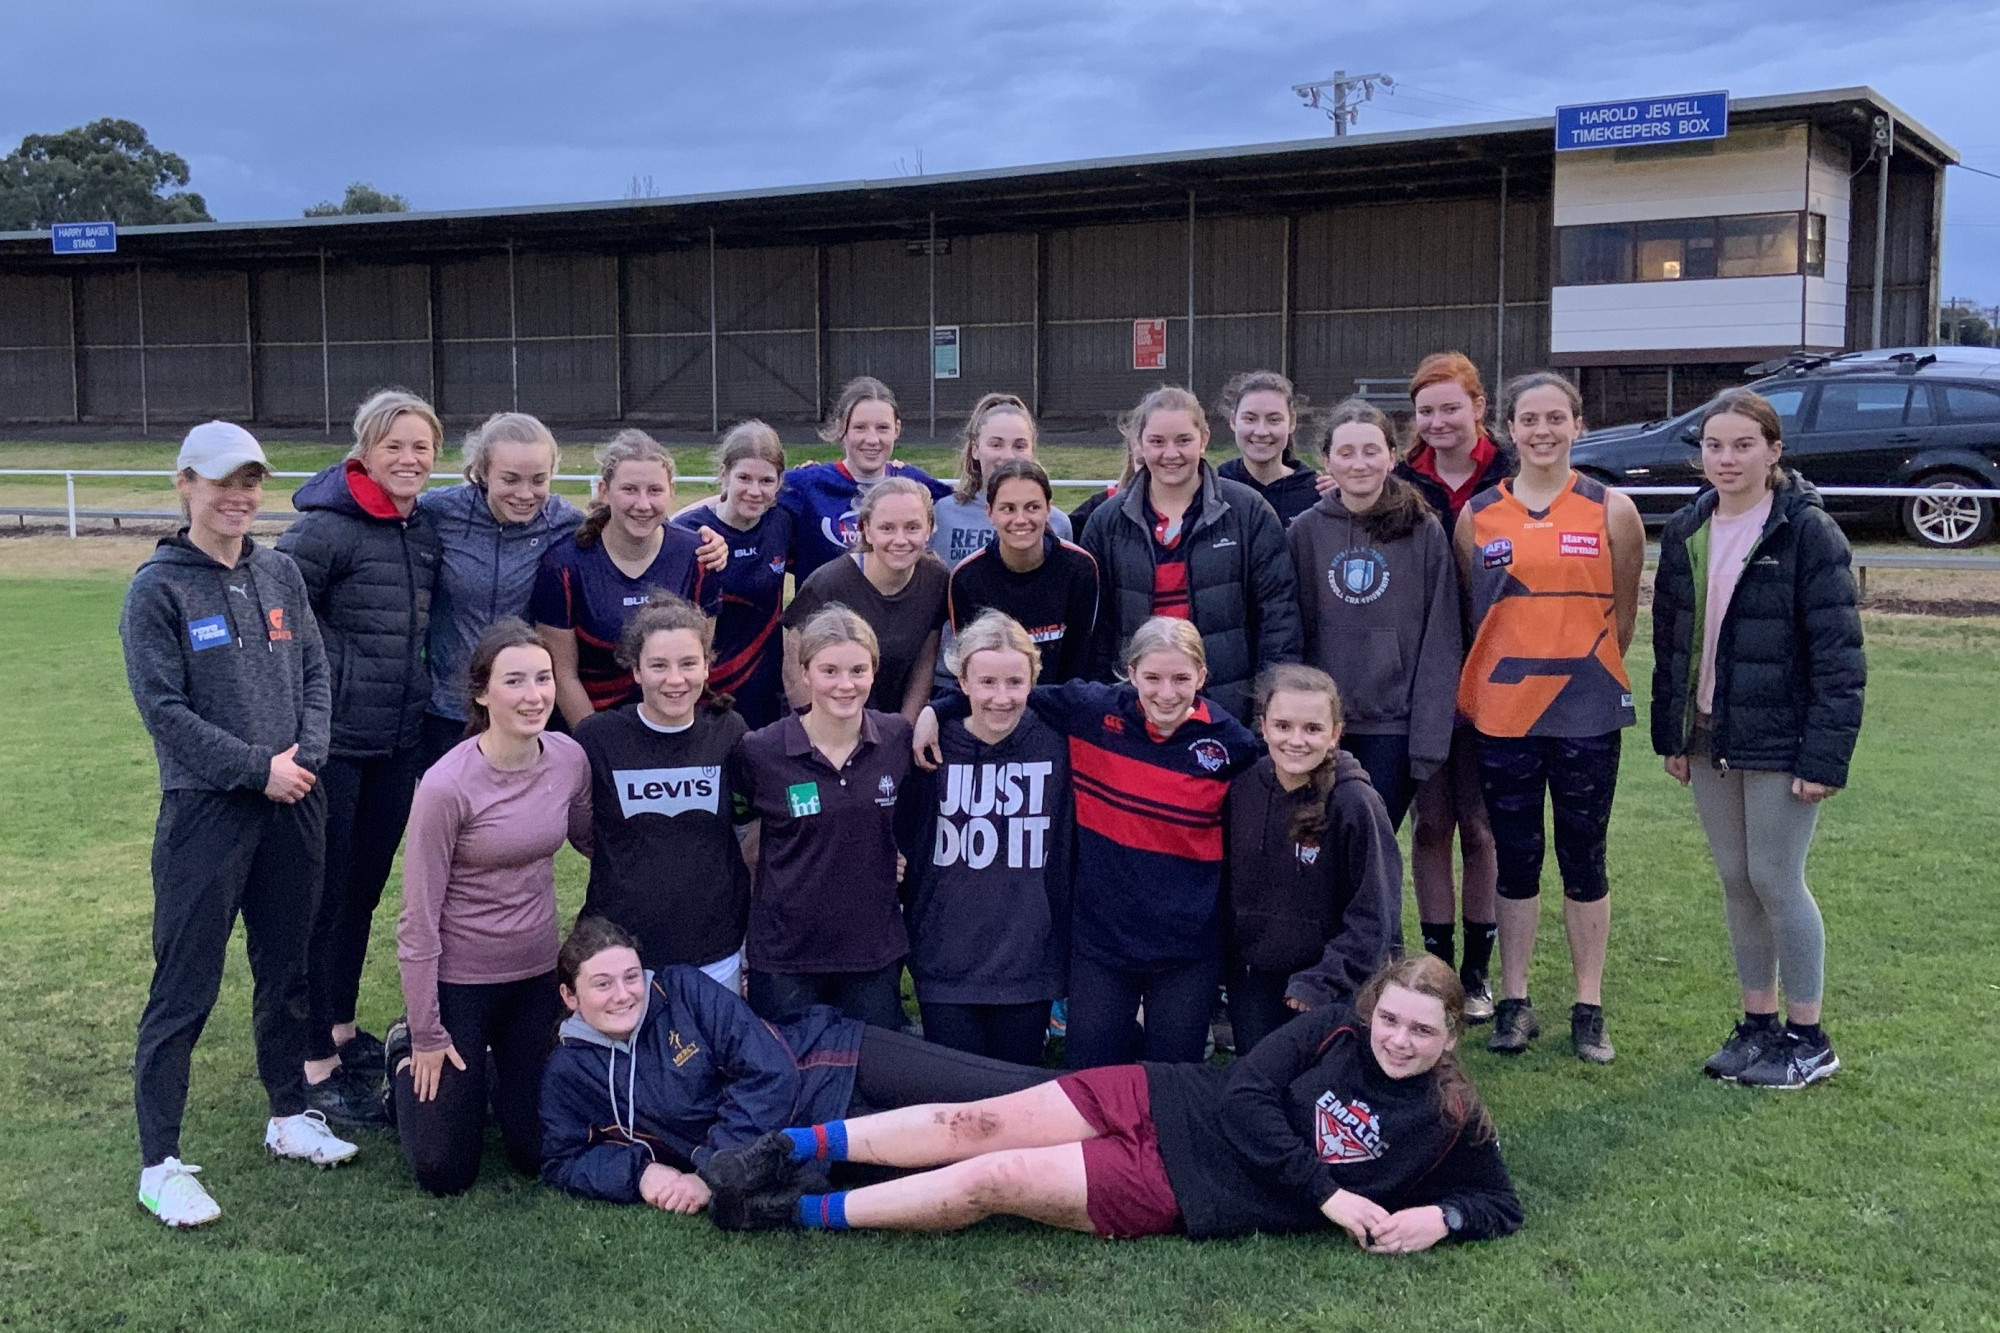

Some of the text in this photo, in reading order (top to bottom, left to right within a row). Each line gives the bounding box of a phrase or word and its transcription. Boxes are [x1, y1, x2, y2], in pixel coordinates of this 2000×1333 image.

[1579, 101, 1702, 125] HAROLD JEWELL
[1571, 118, 1711, 143] TIMEKEEPERS BOX
[58, 226, 109, 237] HARRY BAKER
[72, 238, 97, 249] STAND
[1562, 534, 1598, 546] Harvey
[734, 547, 757, 558] BLK
[1485, 541, 1511, 554] AFL
[1561, 545, 1599, 555] Norman
[627, 779, 713, 800] Levi's
[940, 761, 1053, 816] JUST
[933, 816, 999, 870] DO
